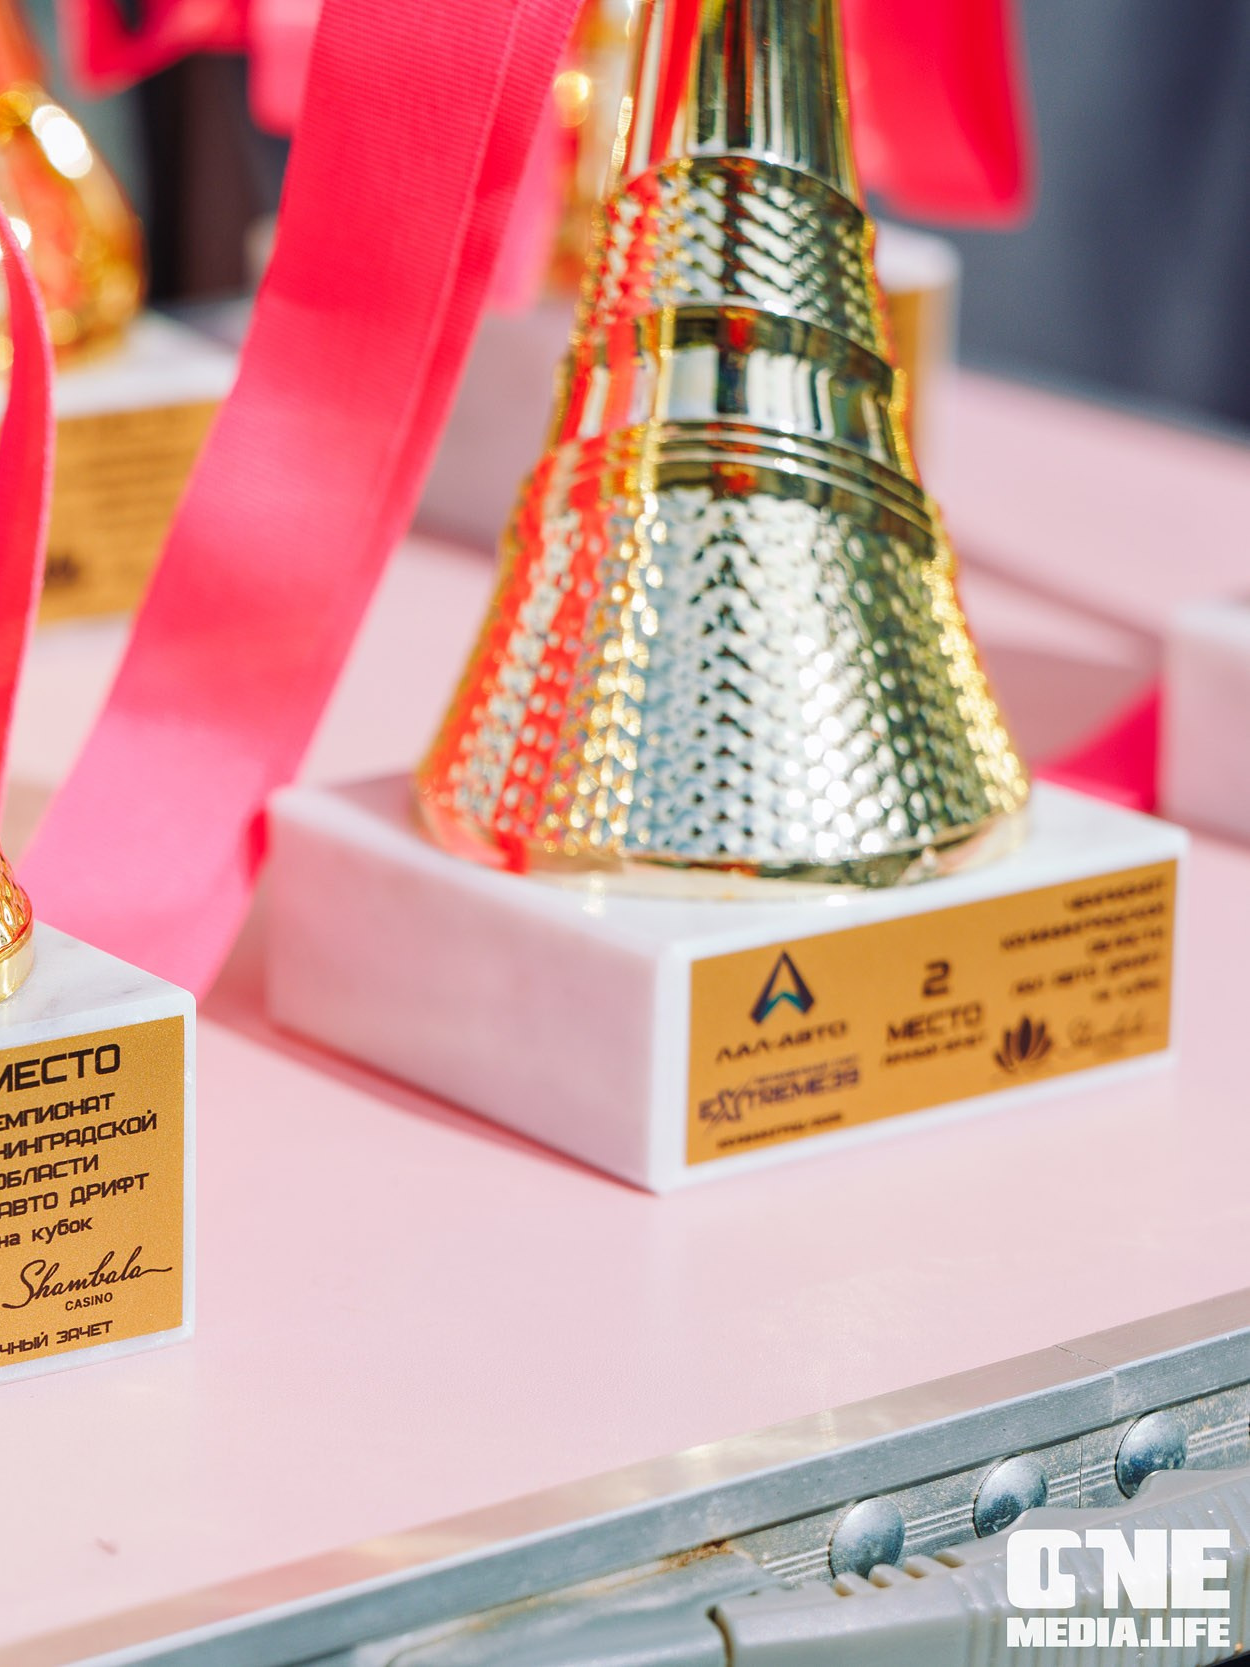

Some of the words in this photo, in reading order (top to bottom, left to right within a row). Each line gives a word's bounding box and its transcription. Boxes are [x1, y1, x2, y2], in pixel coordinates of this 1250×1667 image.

[922, 958, 951, 999] 2
[887, 1002, 983, 1043] МЕСТО
[69, 1172, 150, 1208] ДРИФТ
[32, 1217, 93, 1244] кубок
[2, 1246, 173, 1309] Shambala
[65, 1292, 113, 1311] CASINO
[56, 1320, 113, 1345] ЗАЧЕТ
